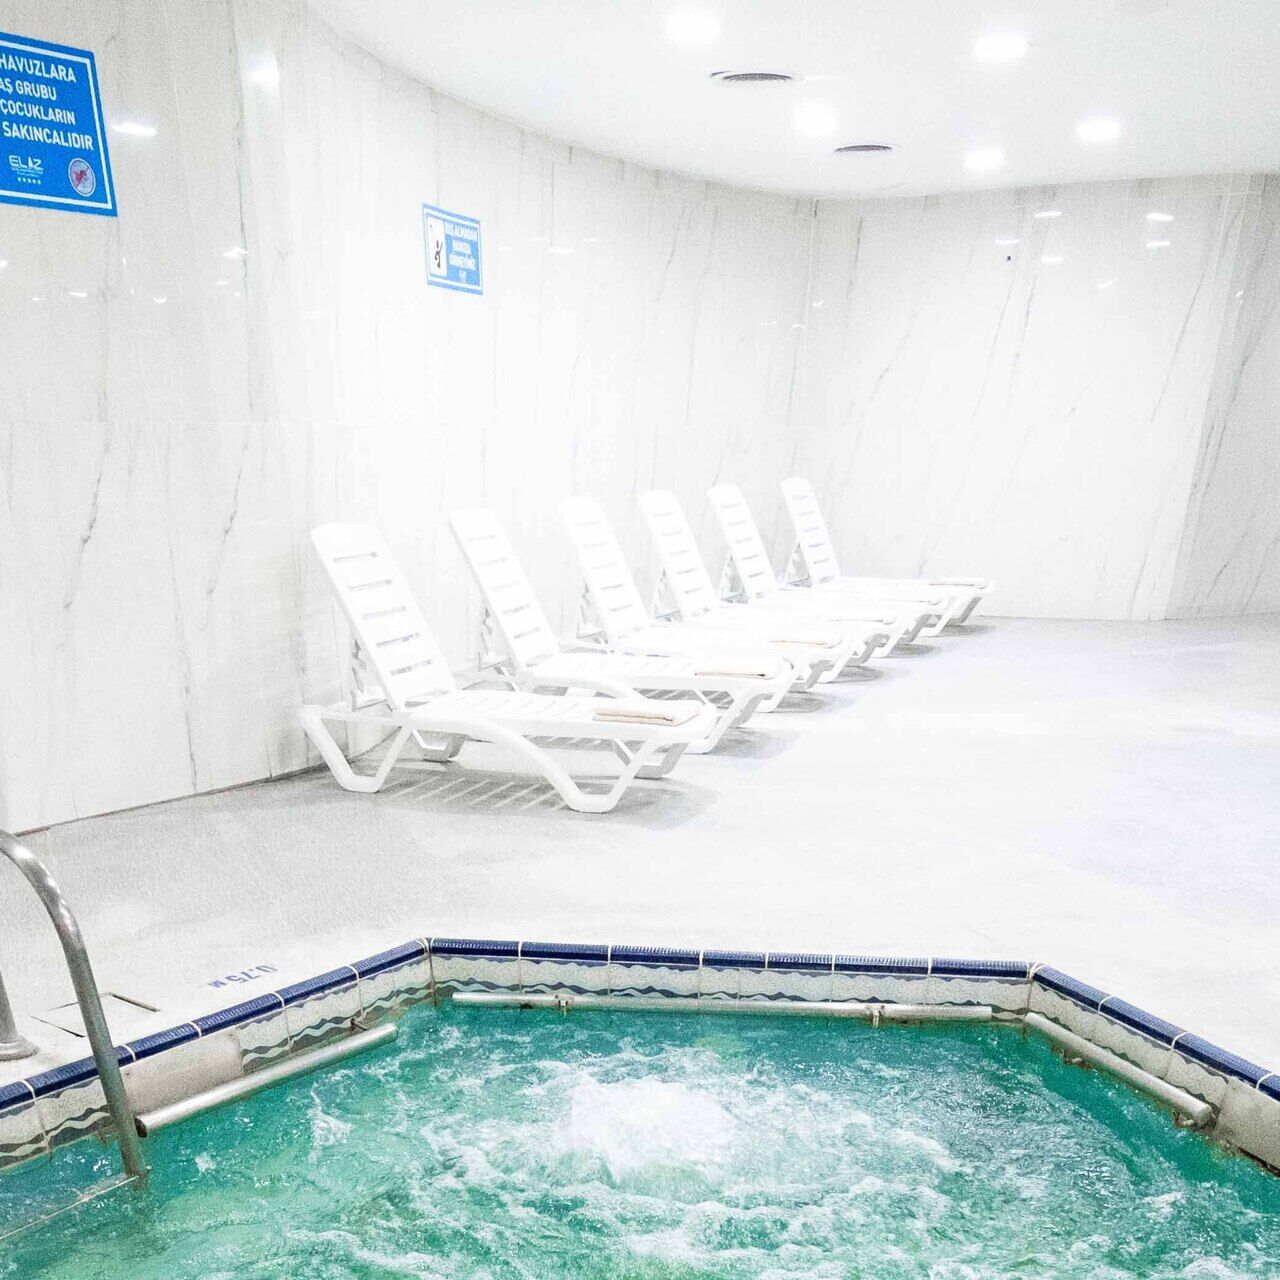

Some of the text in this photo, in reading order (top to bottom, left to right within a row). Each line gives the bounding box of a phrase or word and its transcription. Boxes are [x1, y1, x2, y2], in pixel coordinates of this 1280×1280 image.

[15, 79, 57, 101] GRUBU
[0, 98, 76, 125] ÇOCUKLARIN
[2, 121, 95, 151] SAKINCALIDIR
